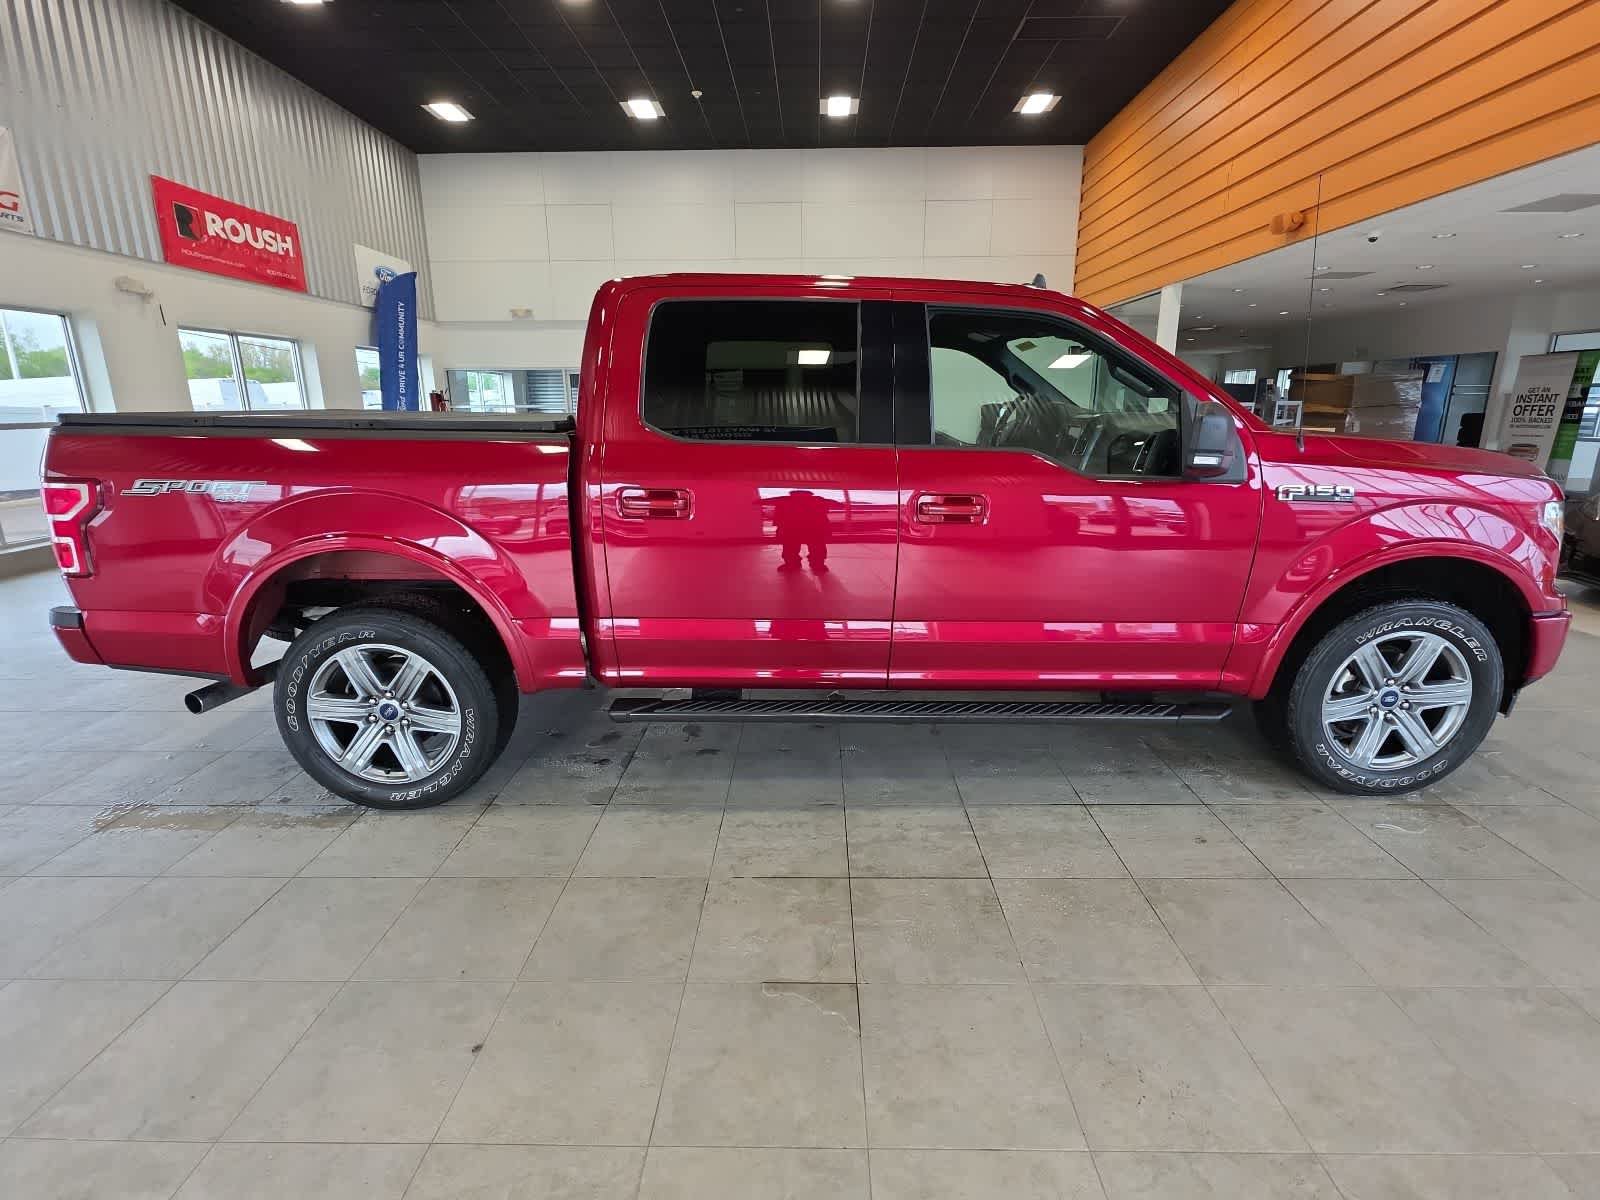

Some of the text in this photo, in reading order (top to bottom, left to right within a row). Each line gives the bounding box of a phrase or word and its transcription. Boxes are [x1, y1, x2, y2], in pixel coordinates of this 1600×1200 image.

[204, 211, 296, 257] ROUSH
[397, 301, 405, 350] COMMUNITY
[398, 351, 405, 362] UR
[398, 370, 406, 393] DRIVE
[1515, 393, 1560, 404] INSTANT
[1513, 404, 1555, 416] OFFER
[120, 478, 267, 496] SPORT
[1355, 616, 1489, 663] WRANGLER
[286, 629, 376, 733] GOODYEAR
[390, 707, 480, 802] WRANGLER
[1316, 742, 1448, 789] GOODYEAR
